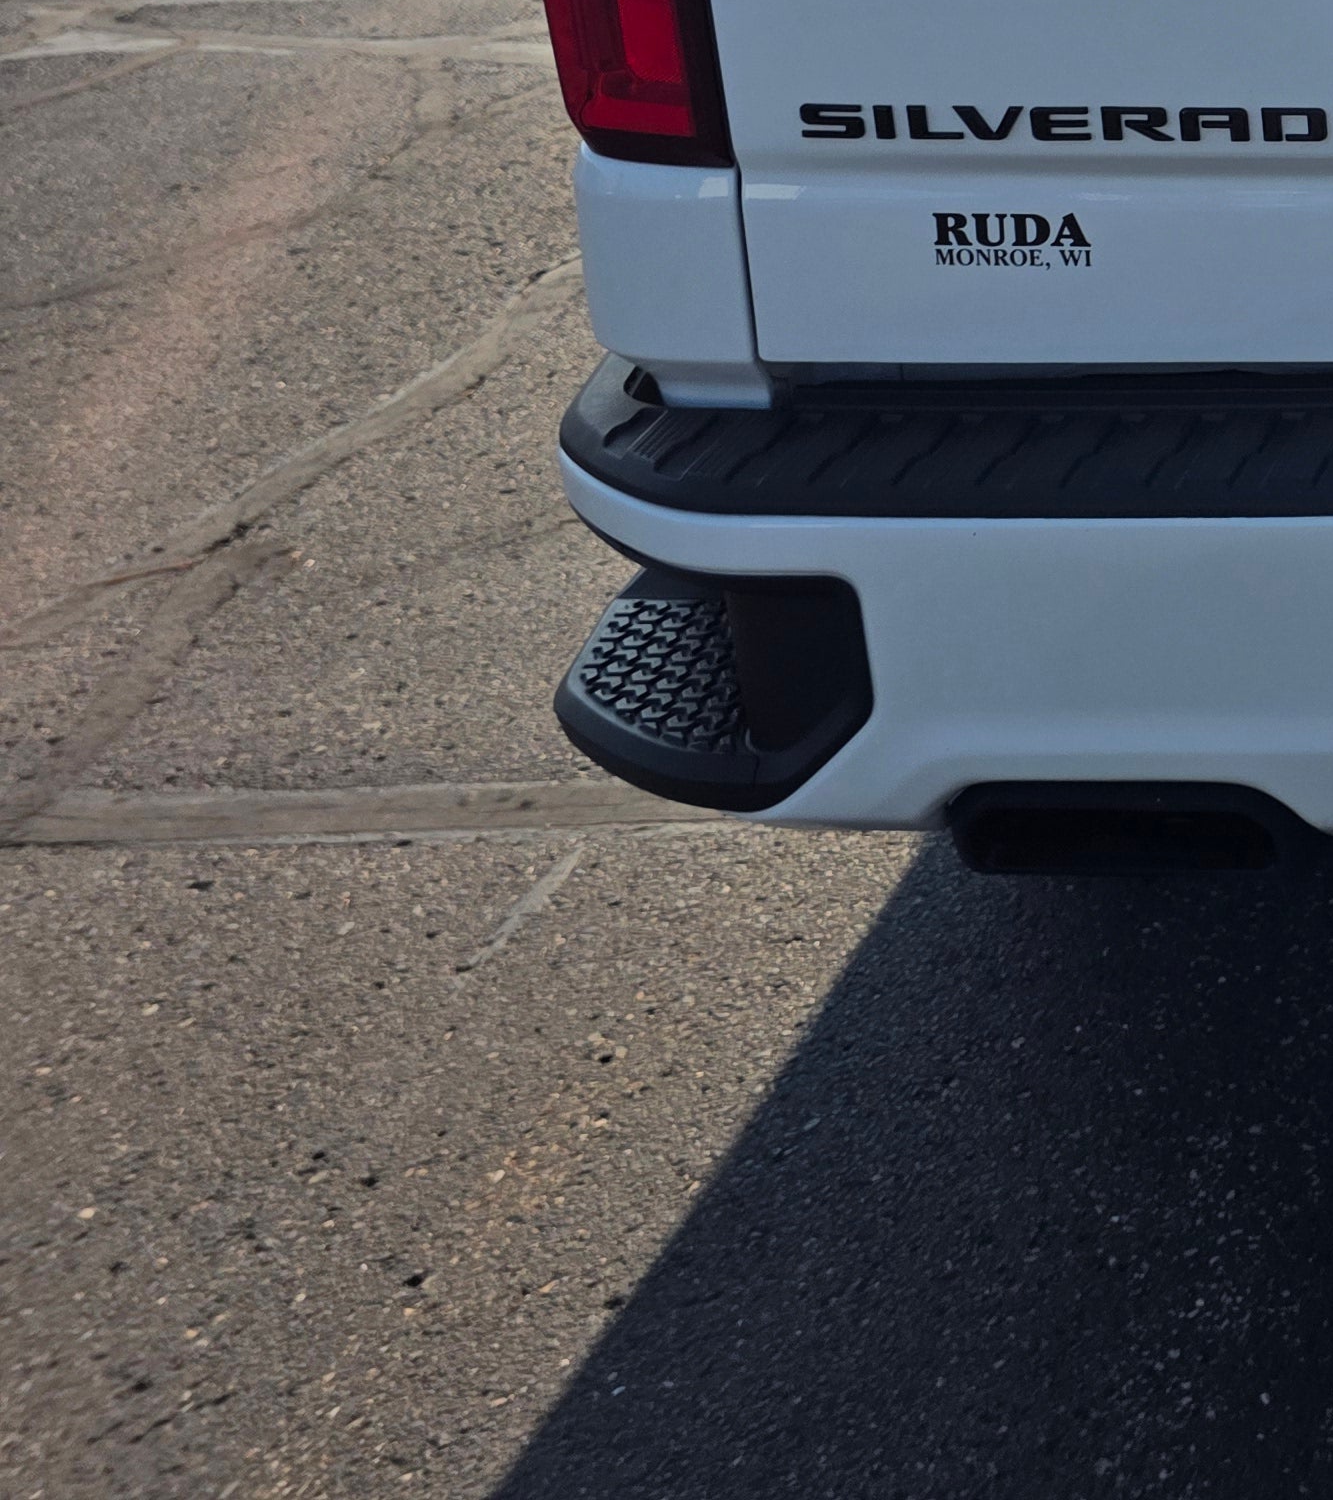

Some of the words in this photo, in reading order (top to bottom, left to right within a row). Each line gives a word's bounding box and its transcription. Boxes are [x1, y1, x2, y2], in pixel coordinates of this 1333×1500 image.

[932, 212, 1092, 247] RUDA
[935, 248, 1051, 271] MONROE,
[1059, 249, 1092, 267] WI
